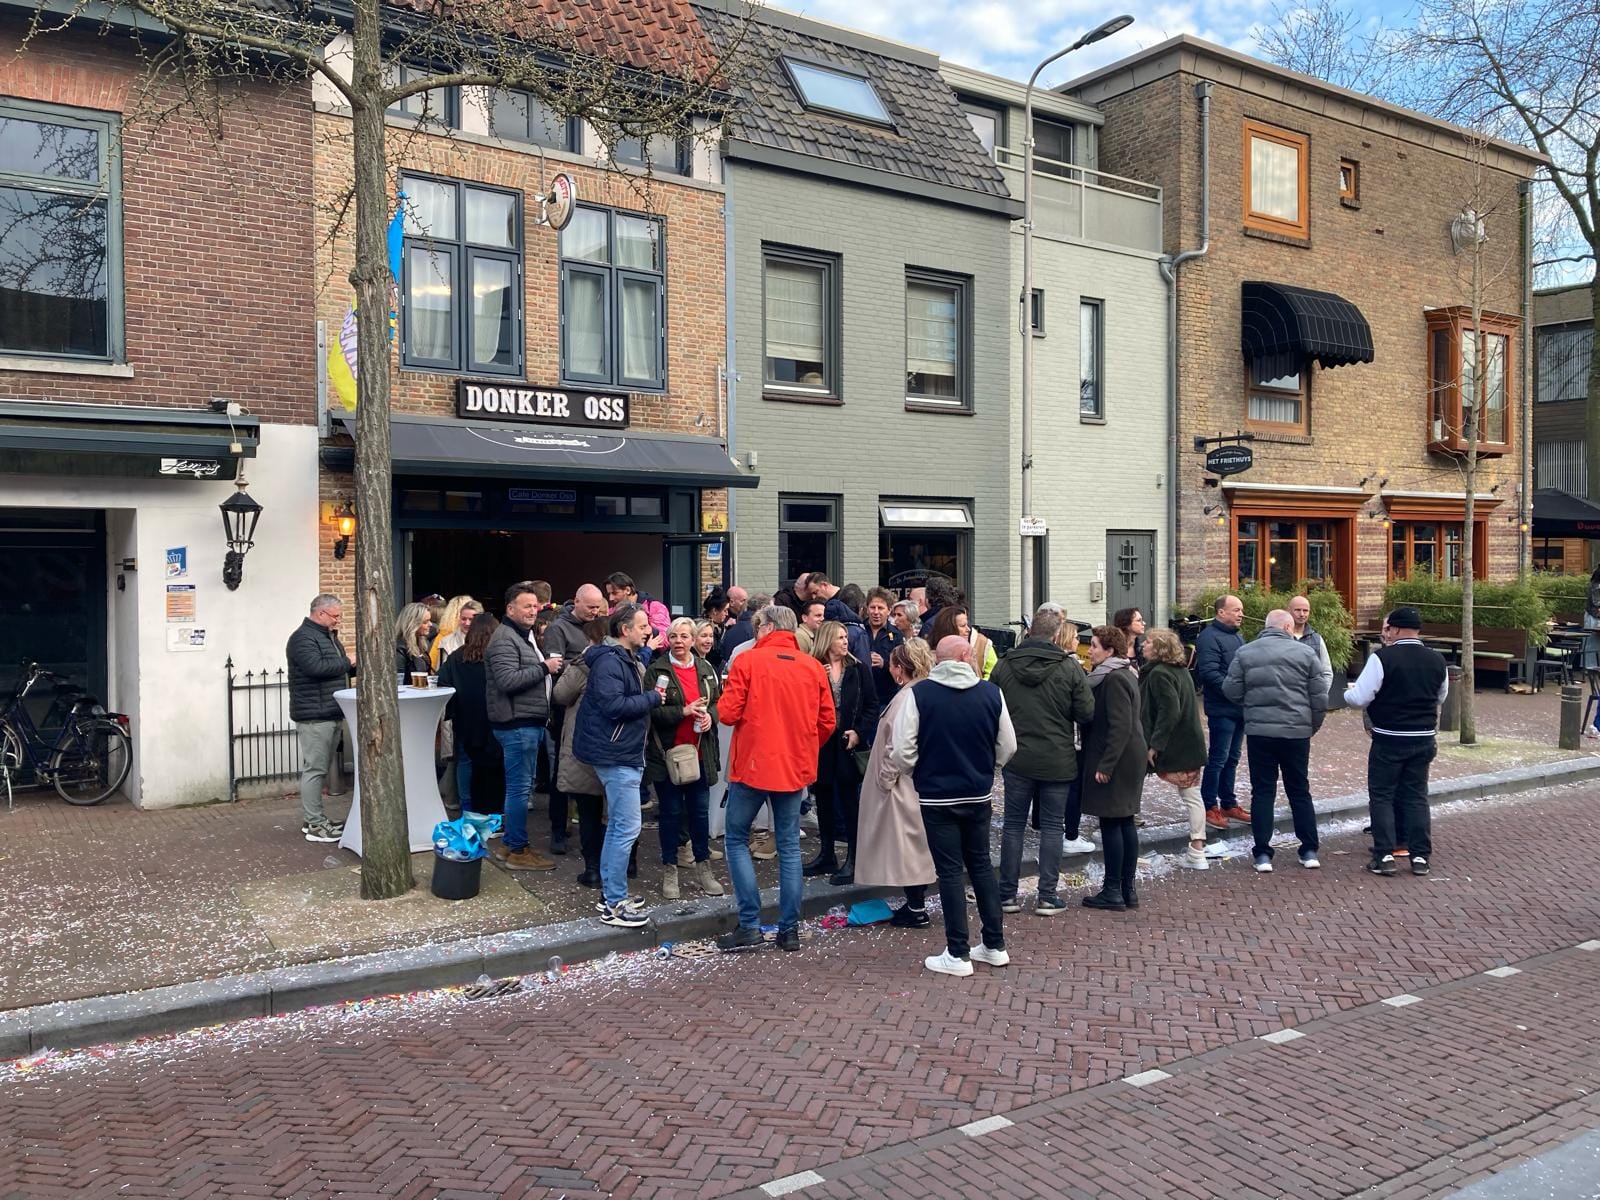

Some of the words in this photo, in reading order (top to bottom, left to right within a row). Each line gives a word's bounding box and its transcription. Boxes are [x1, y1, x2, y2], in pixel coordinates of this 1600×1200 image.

[466, 386, 570, 418] DONKER
[584, 396, 625, 421] OSS
[1220, 456, 1251, 465] FRIETHUYS
[531, 491, 557, 499] Donker
[559, 492, 573, 500] Oss
[709, 563, 720, 579] 5
